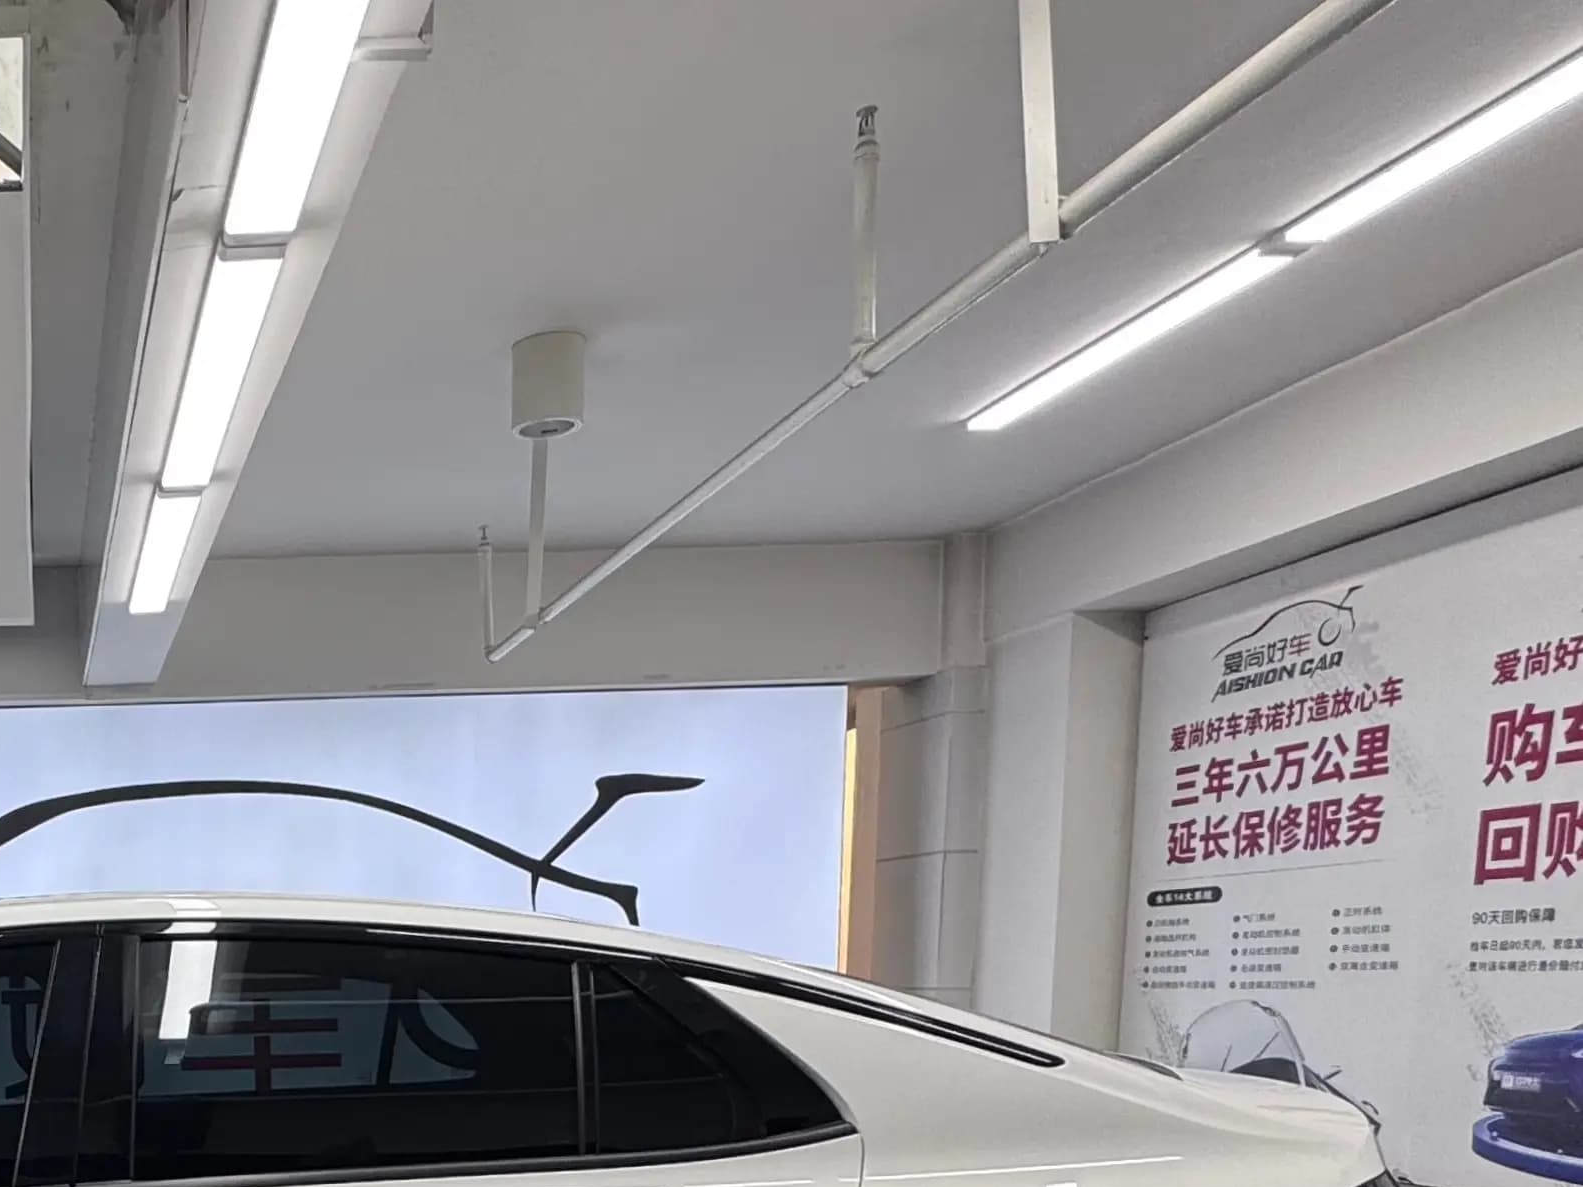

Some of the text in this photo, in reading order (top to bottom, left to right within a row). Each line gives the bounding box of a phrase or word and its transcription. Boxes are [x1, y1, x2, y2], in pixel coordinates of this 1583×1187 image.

[1211, 651, 1343, 703] AISHION CAR
[1223, 633, 1312, 675] 爱尚好车
[1169, 676, 1404, 752] 爱尚好车承诺打造放心车
[1171, 724, 1390, 808] 三年六万公里
[1167, 793, 1386, 866] 延长保修服务
